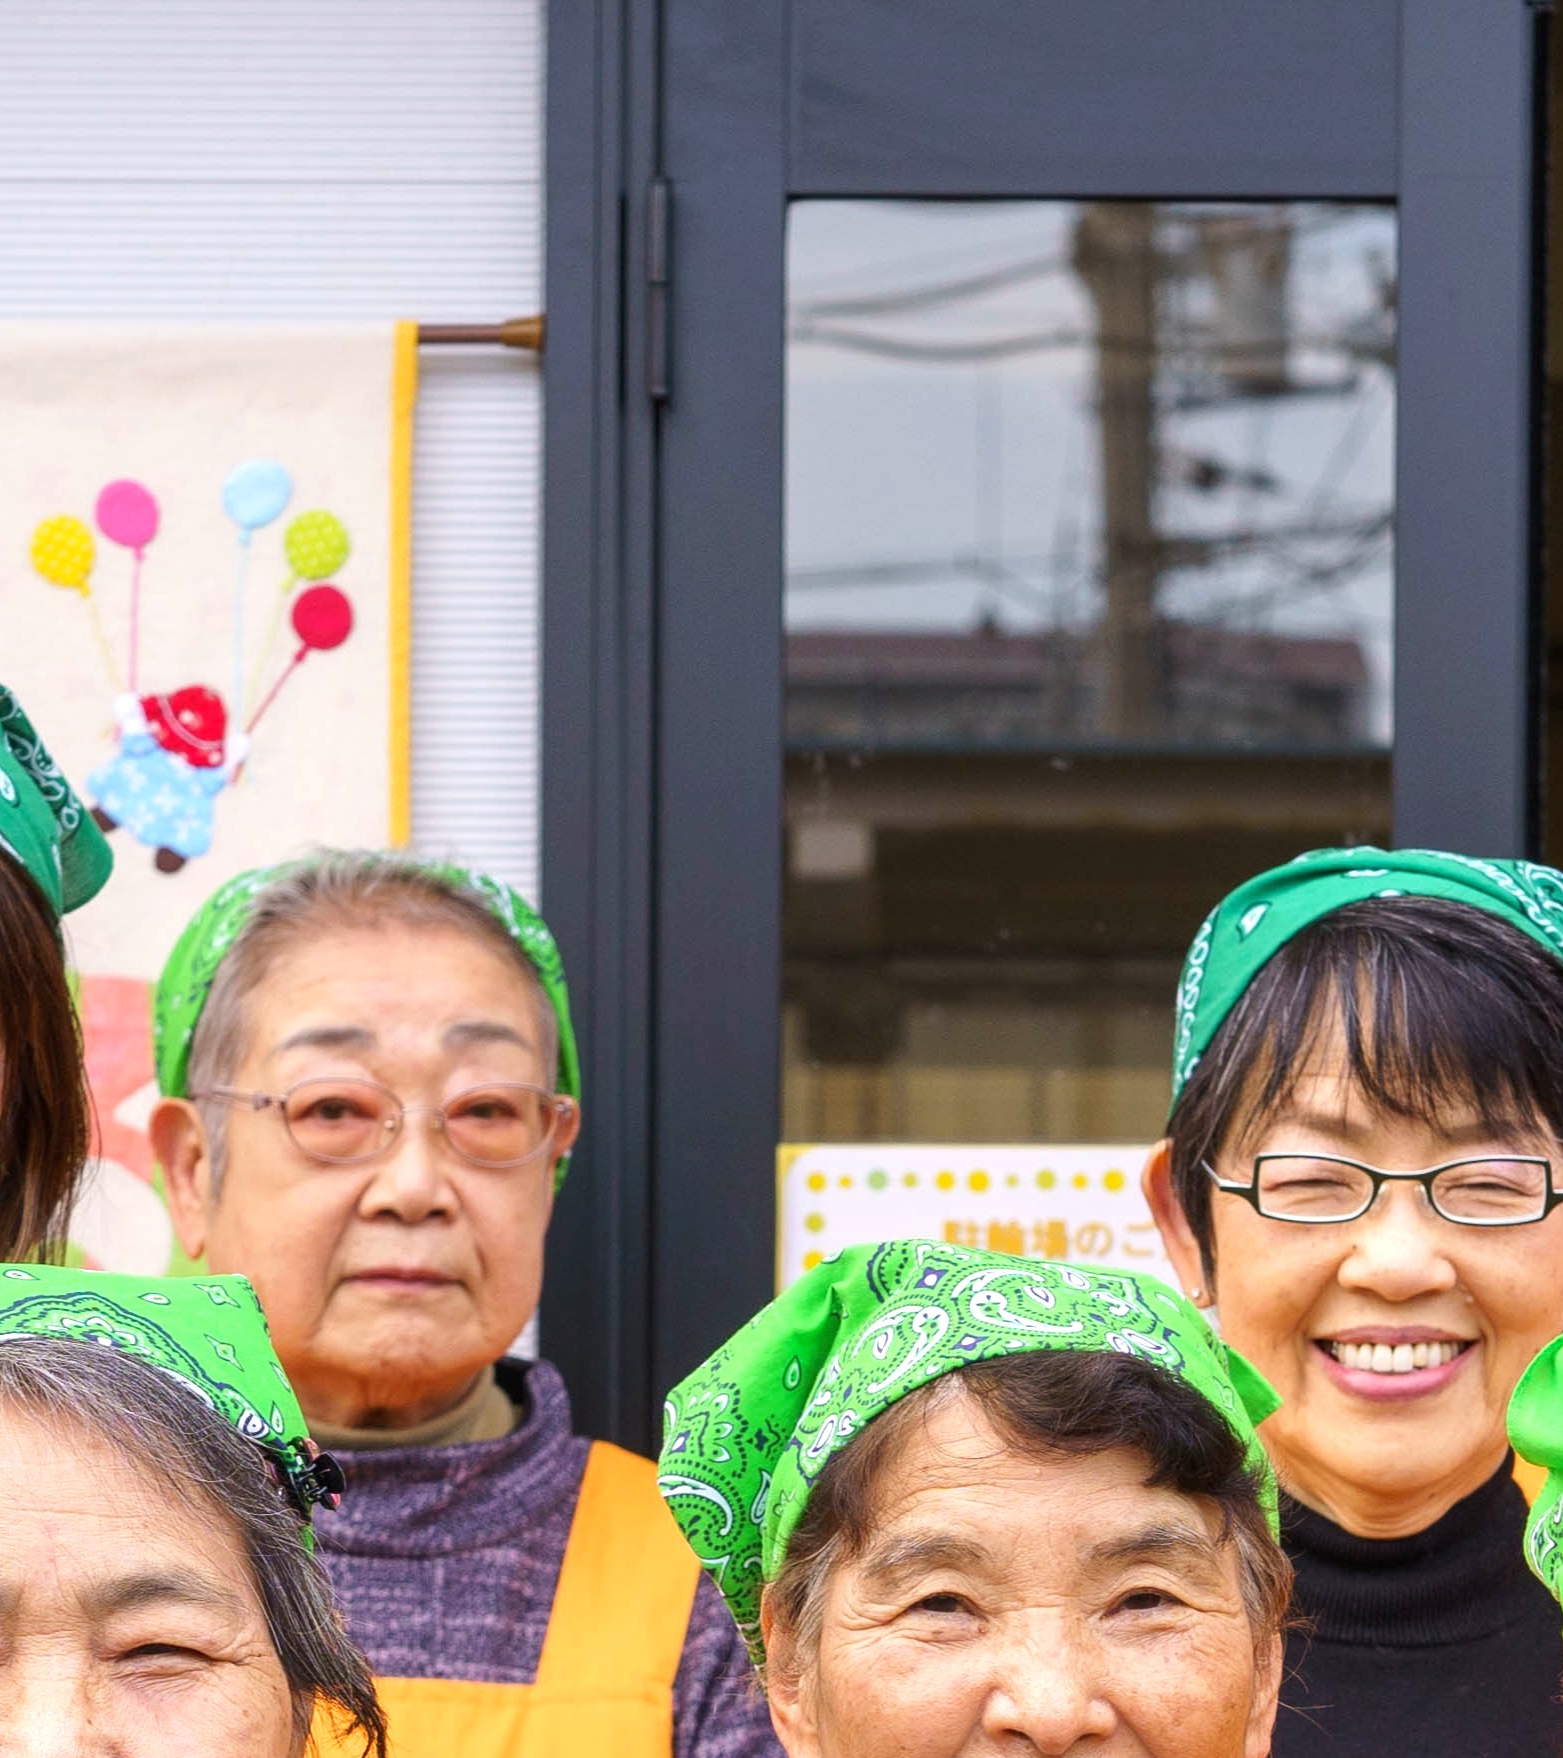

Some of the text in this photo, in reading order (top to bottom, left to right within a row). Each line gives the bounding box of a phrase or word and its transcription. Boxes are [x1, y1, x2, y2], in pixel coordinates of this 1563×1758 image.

[942, 1219, 1166, 1260] 駐輪場のご
